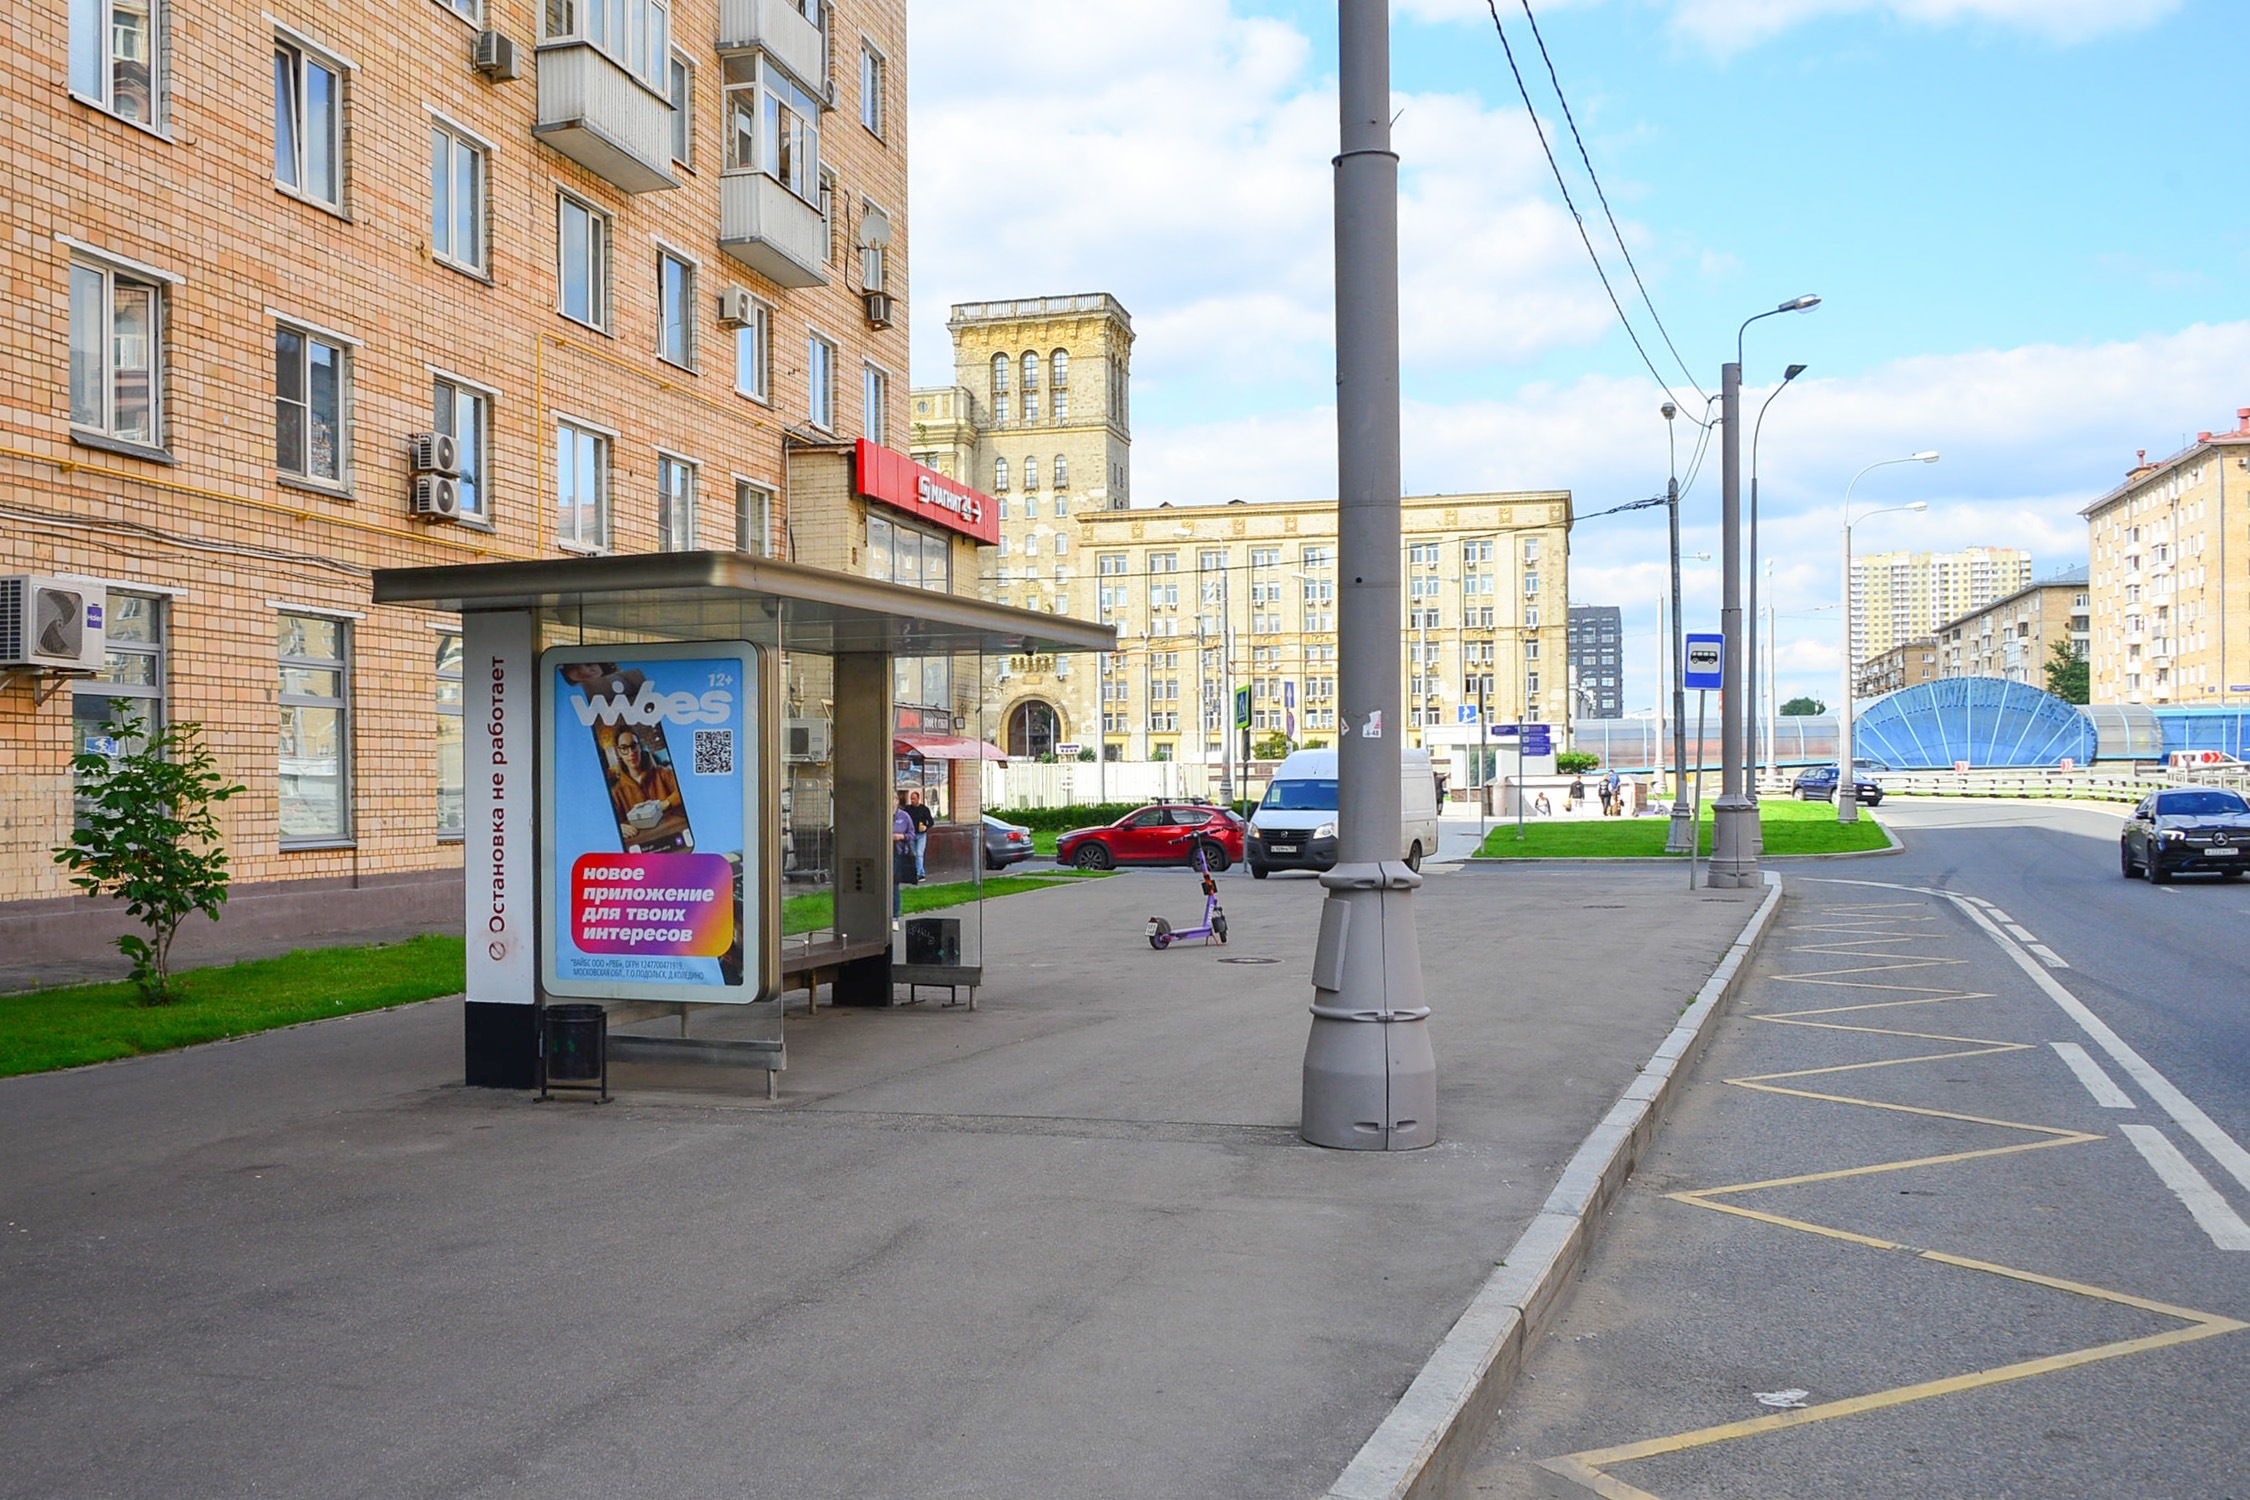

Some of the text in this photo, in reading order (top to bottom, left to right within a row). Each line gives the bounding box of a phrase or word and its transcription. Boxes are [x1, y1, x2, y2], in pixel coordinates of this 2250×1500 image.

[931, 484, 962, 513] МАГНИТ
[708, 673, 733, 687] 12+
[570, 680, 733, 727] vibes
[487, 656, 508, 933] Остановка не работает
[582, 867, 645, 881] новое
[583, 887, 715, 905] приложение
[582, 907, 686, 923] для твоих
[583, 927, 693, 945] интересов
[573, 968, 610, 977] МОСКОВСКАЯ
[625, 960, 640, 968] ОГРН
